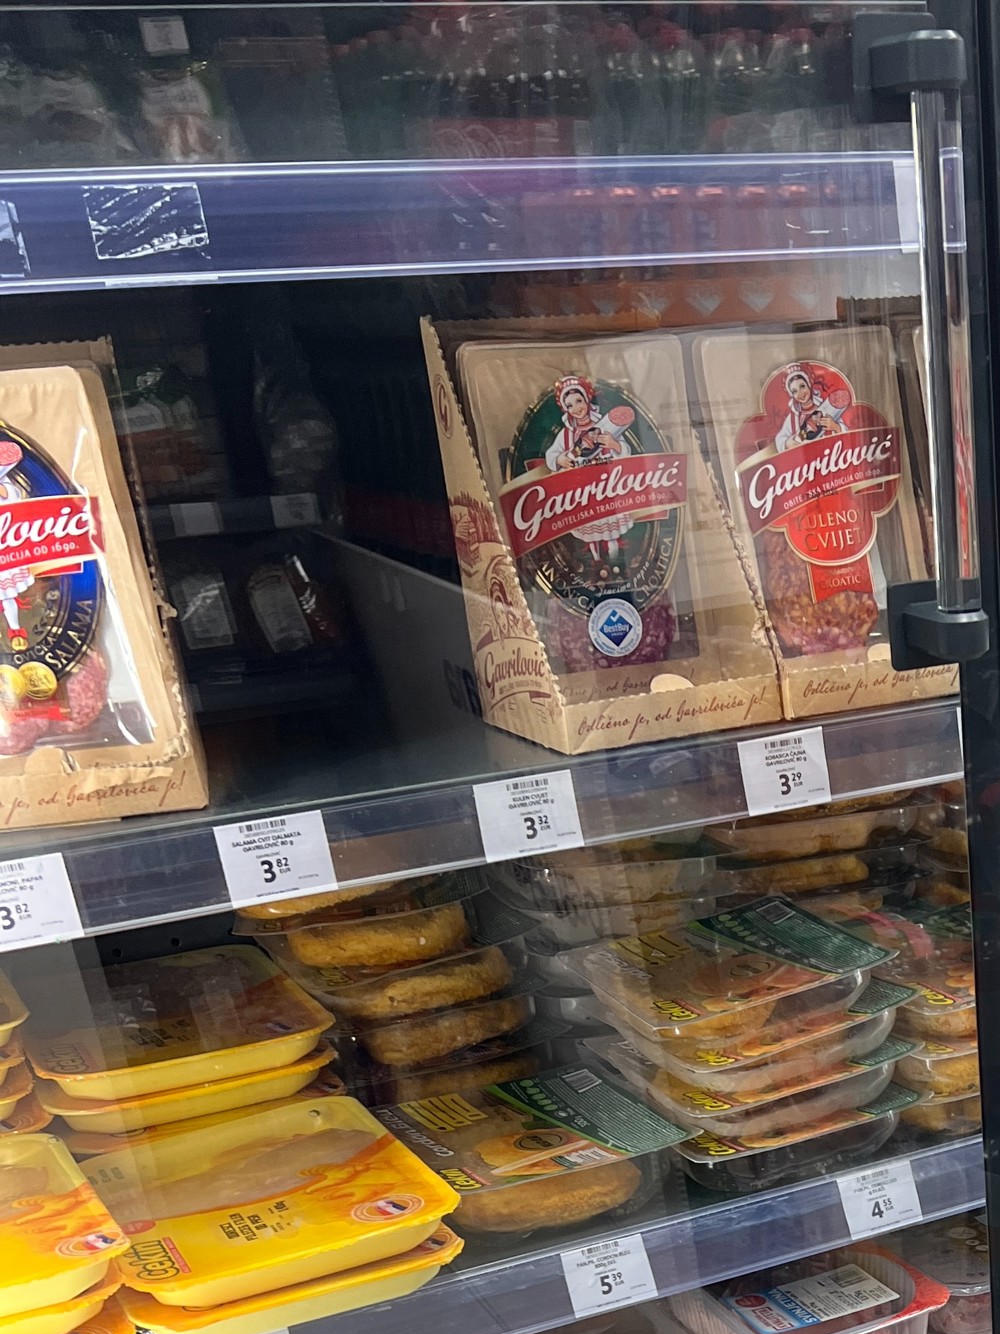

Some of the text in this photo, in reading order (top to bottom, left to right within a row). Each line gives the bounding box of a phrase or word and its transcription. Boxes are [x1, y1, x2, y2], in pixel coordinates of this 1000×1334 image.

[749, 434, 892, 519] Gavrilović
[822, 474, 854, 493] TRADICIJA
[514, 460, 681, 542] Gavrilović
[552, 509, 595, 531] OBITELJSKA
[596, 497, 634, 515] TRADICIJA
[636, 495, 647, 504] OD
[796, 508, 866, 532] KULENOV
[33, 541, 80, 556] OD 1690.
[804, 526, 864, 552] CVIJET
[634, 536, 674, 603] CROATICA
[45, 600, 94, 672] SALAMA
[603, 622, 631, 634] BestBuy
[484, 651, 546, 699] Gavrilović
[873, 674, 889, 686] od
[655, 708, 672, 720] od
[765, 749, 807, 761] KOBASICA ČAJNA
[779, 771, 803, 796] 3 29
[512, 795, 530, 803] KULEN
[231, 830, 302, 849] SALAMA CVIT DALMATA
[523, 814, 549, 840] 3 32
[242, 840, 281, 853] GAVRILOVIĆ
[260, 856, 291, 884] 3 82
[279, 865, 292, 875] EUR
[0, 903, 30, 931] 3 82
[650, 999, 701, 1022] Cekin
[405, 1130, 455, 1158] Cordon
[440, 1168, 482, 1191] Cekin
[871, 1197, 893, 1219] 4 55
[124, 1239, 180, 1281] Cekin
[600, 1271, 623, 1296] 5 39
[767, 1287, 819, 1325] SVINJETINA
